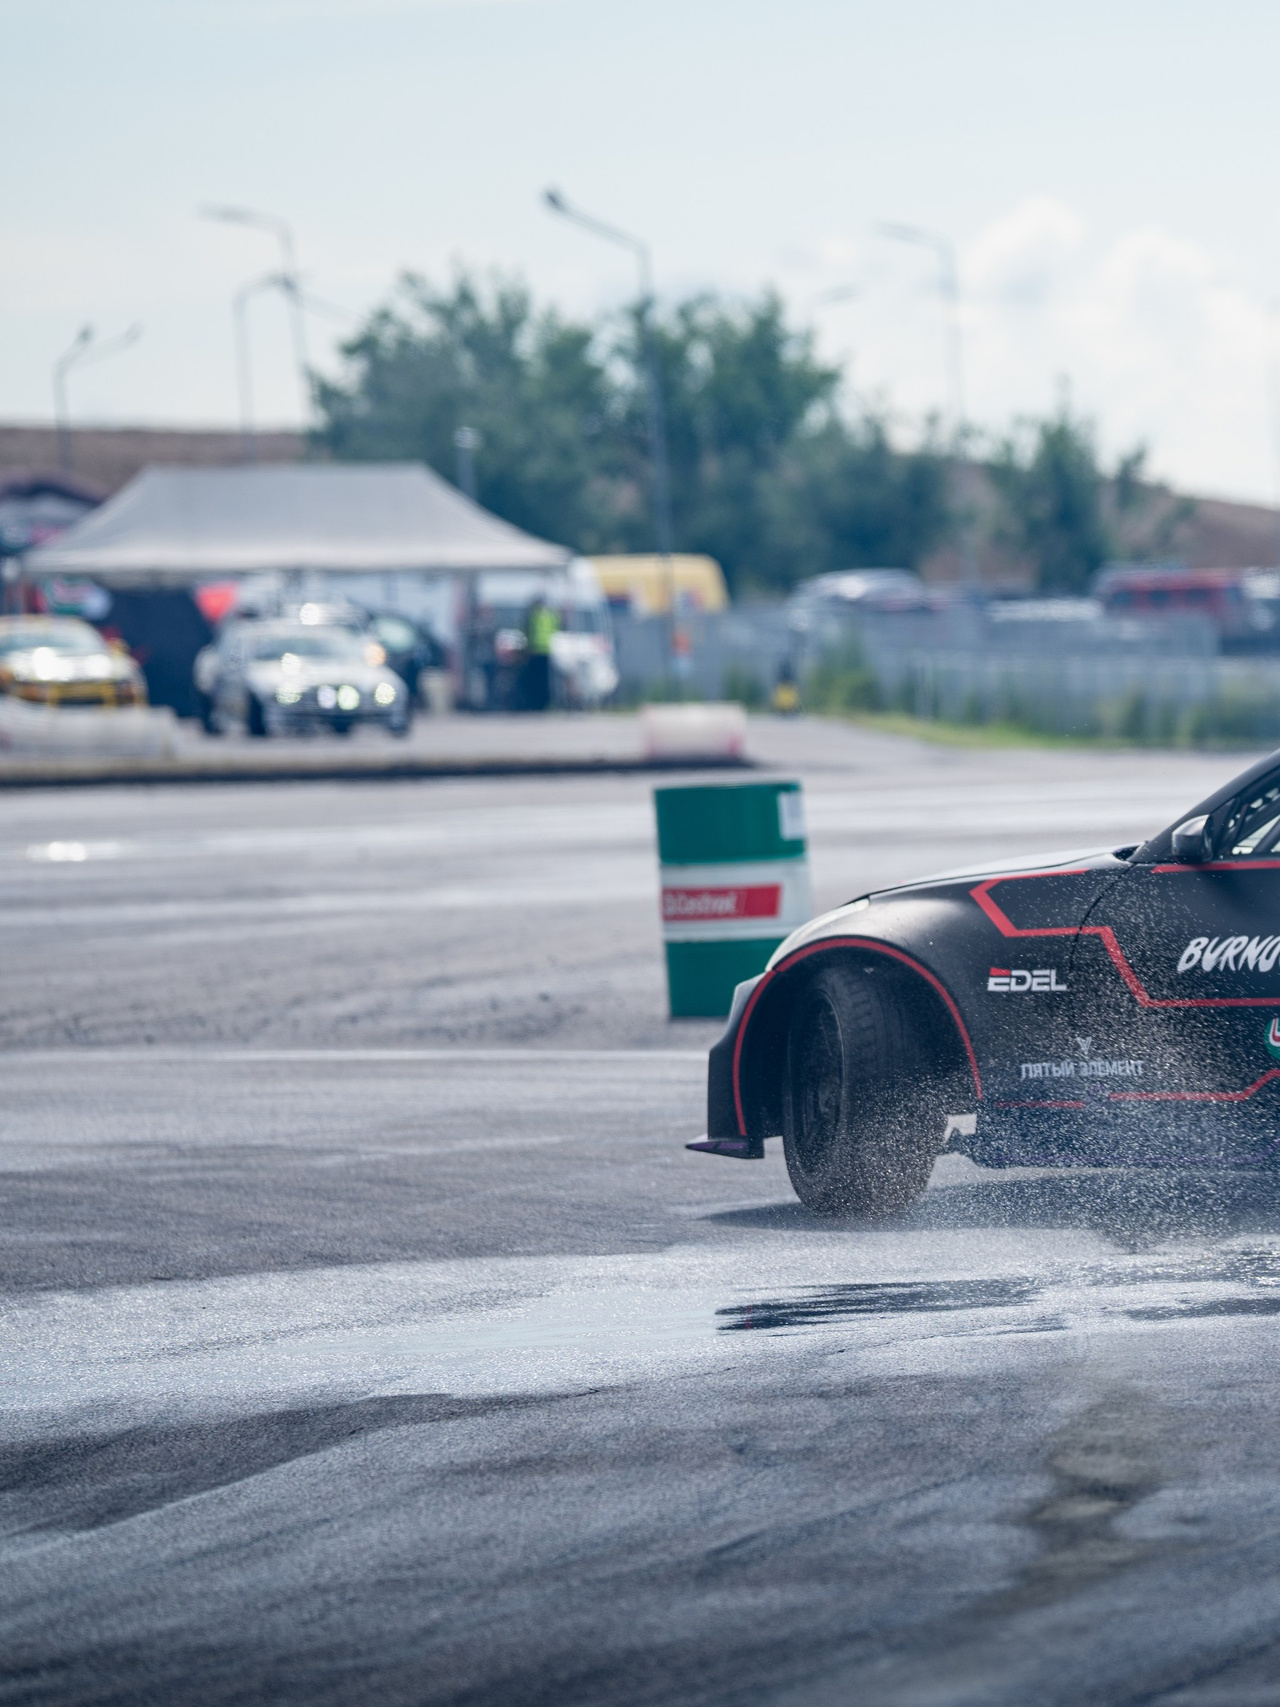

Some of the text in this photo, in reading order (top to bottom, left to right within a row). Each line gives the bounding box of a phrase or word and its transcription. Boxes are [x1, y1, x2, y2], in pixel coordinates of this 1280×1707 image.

[677, 890, 738, 915] Castrol
[987, 967, 1068, 992] EDEL
[1020, 1058, 1144, 1079] ПЯТЫЙ ЭЛЕМЕНТ
